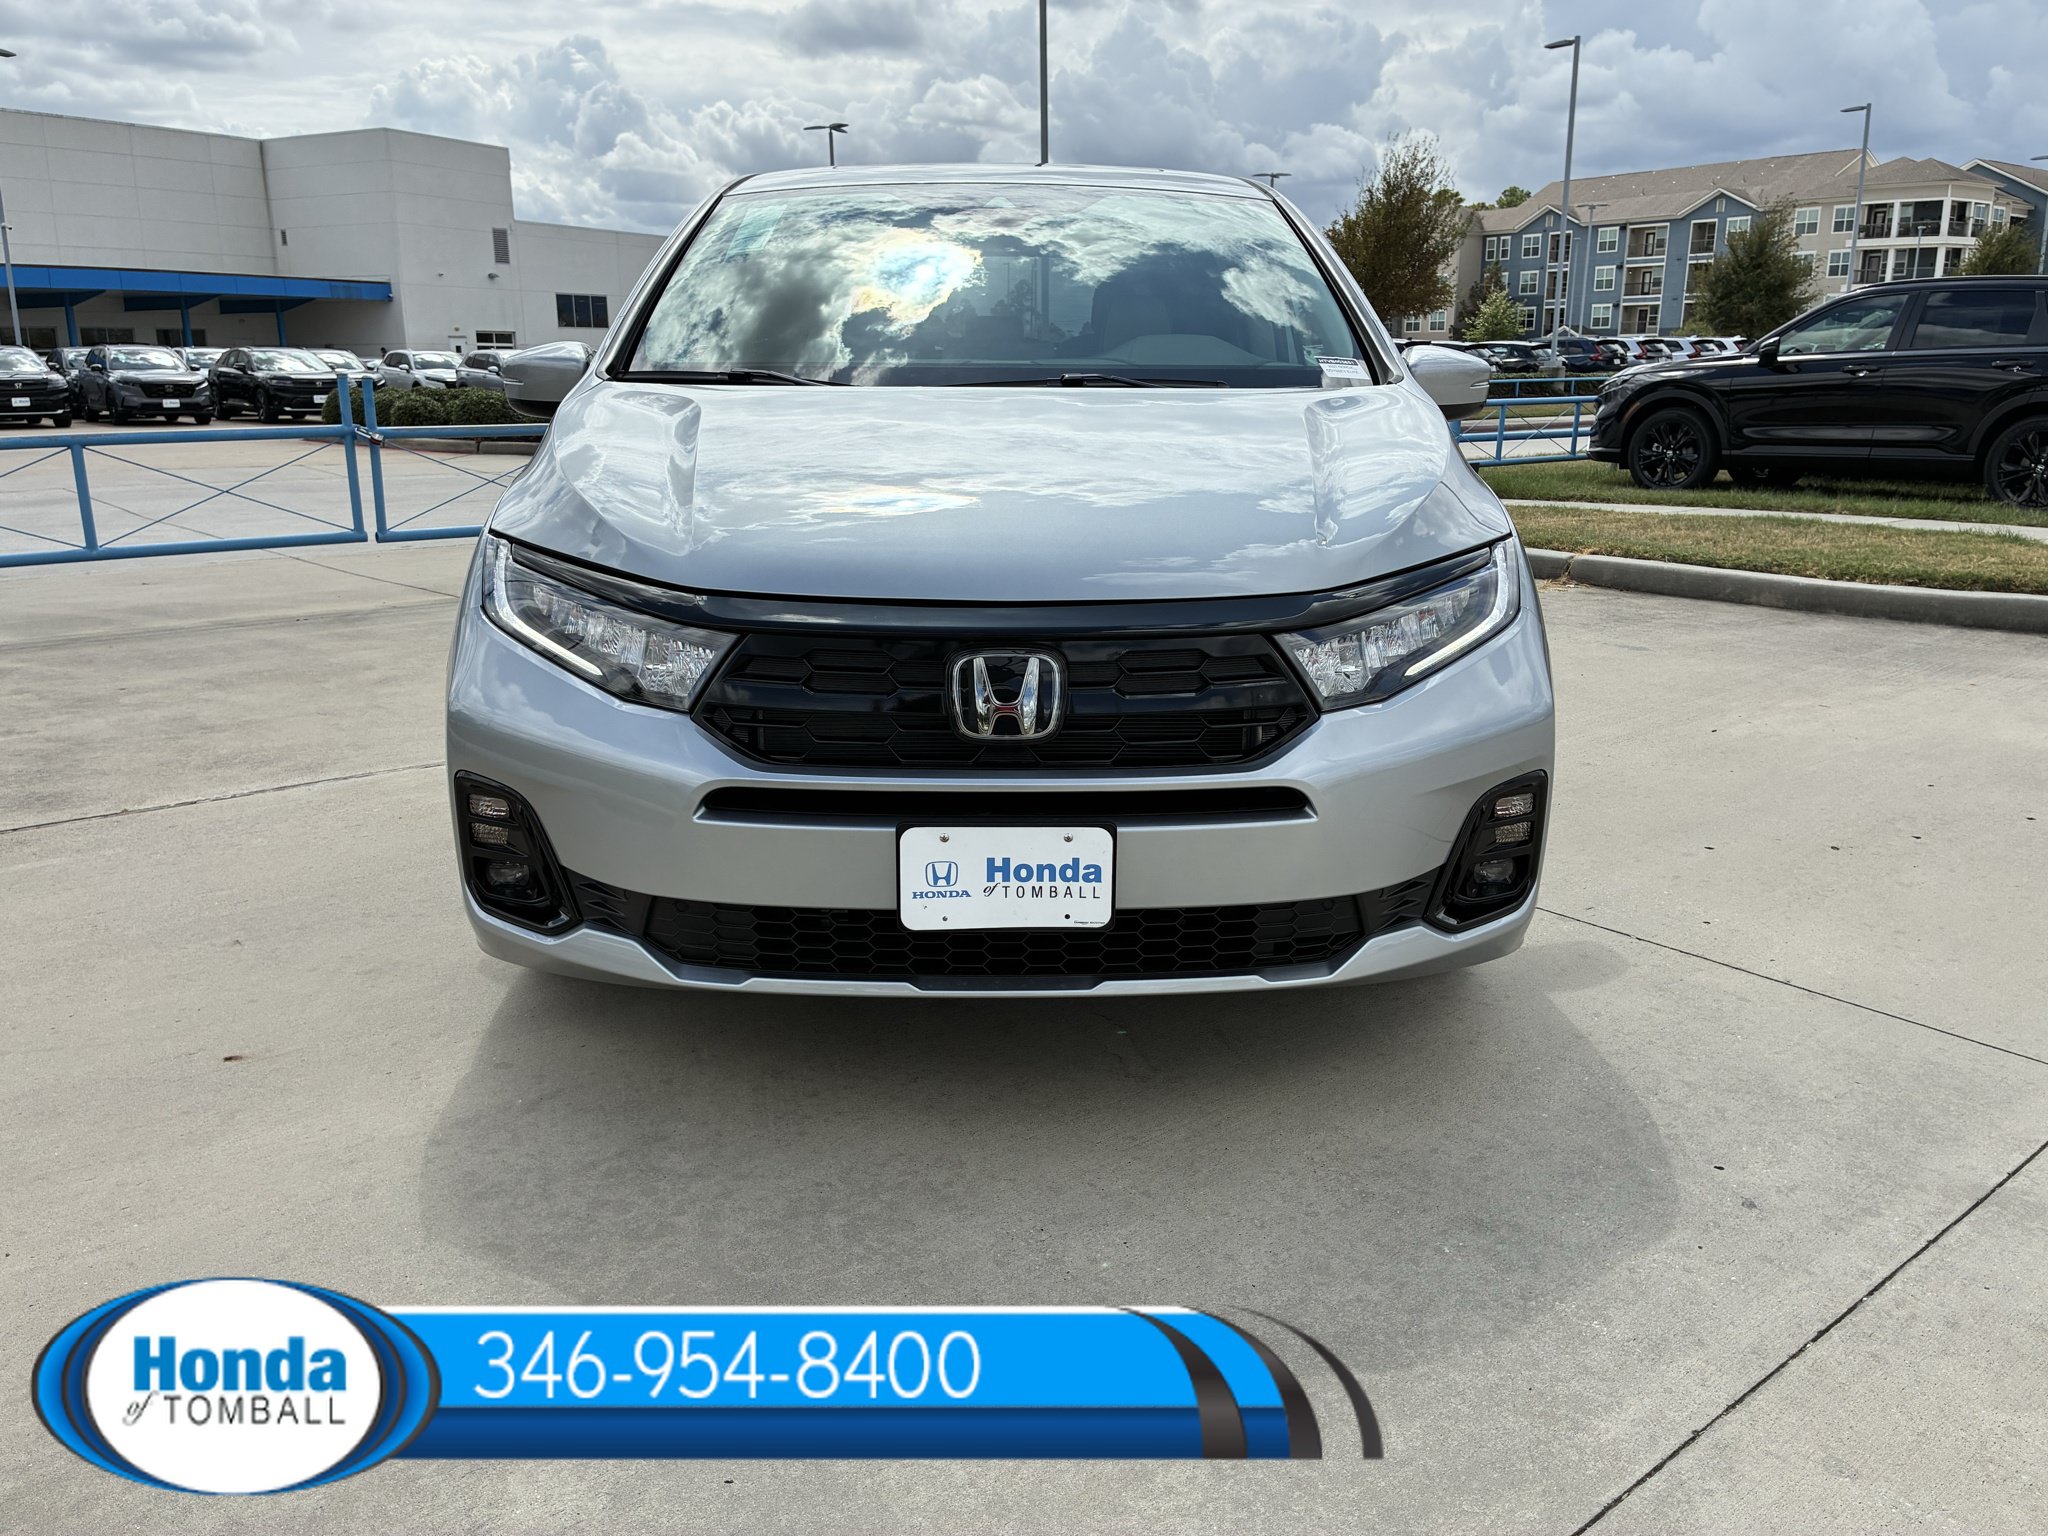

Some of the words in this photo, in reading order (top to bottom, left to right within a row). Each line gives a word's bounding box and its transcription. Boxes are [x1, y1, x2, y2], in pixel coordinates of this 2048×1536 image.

[986, 857, 1102, 883] Honda
[912, 889, 972, 899] HONDA
[982, 882, 1001, 898] of
[1003, 885, 1101, 899] TOMBALL
